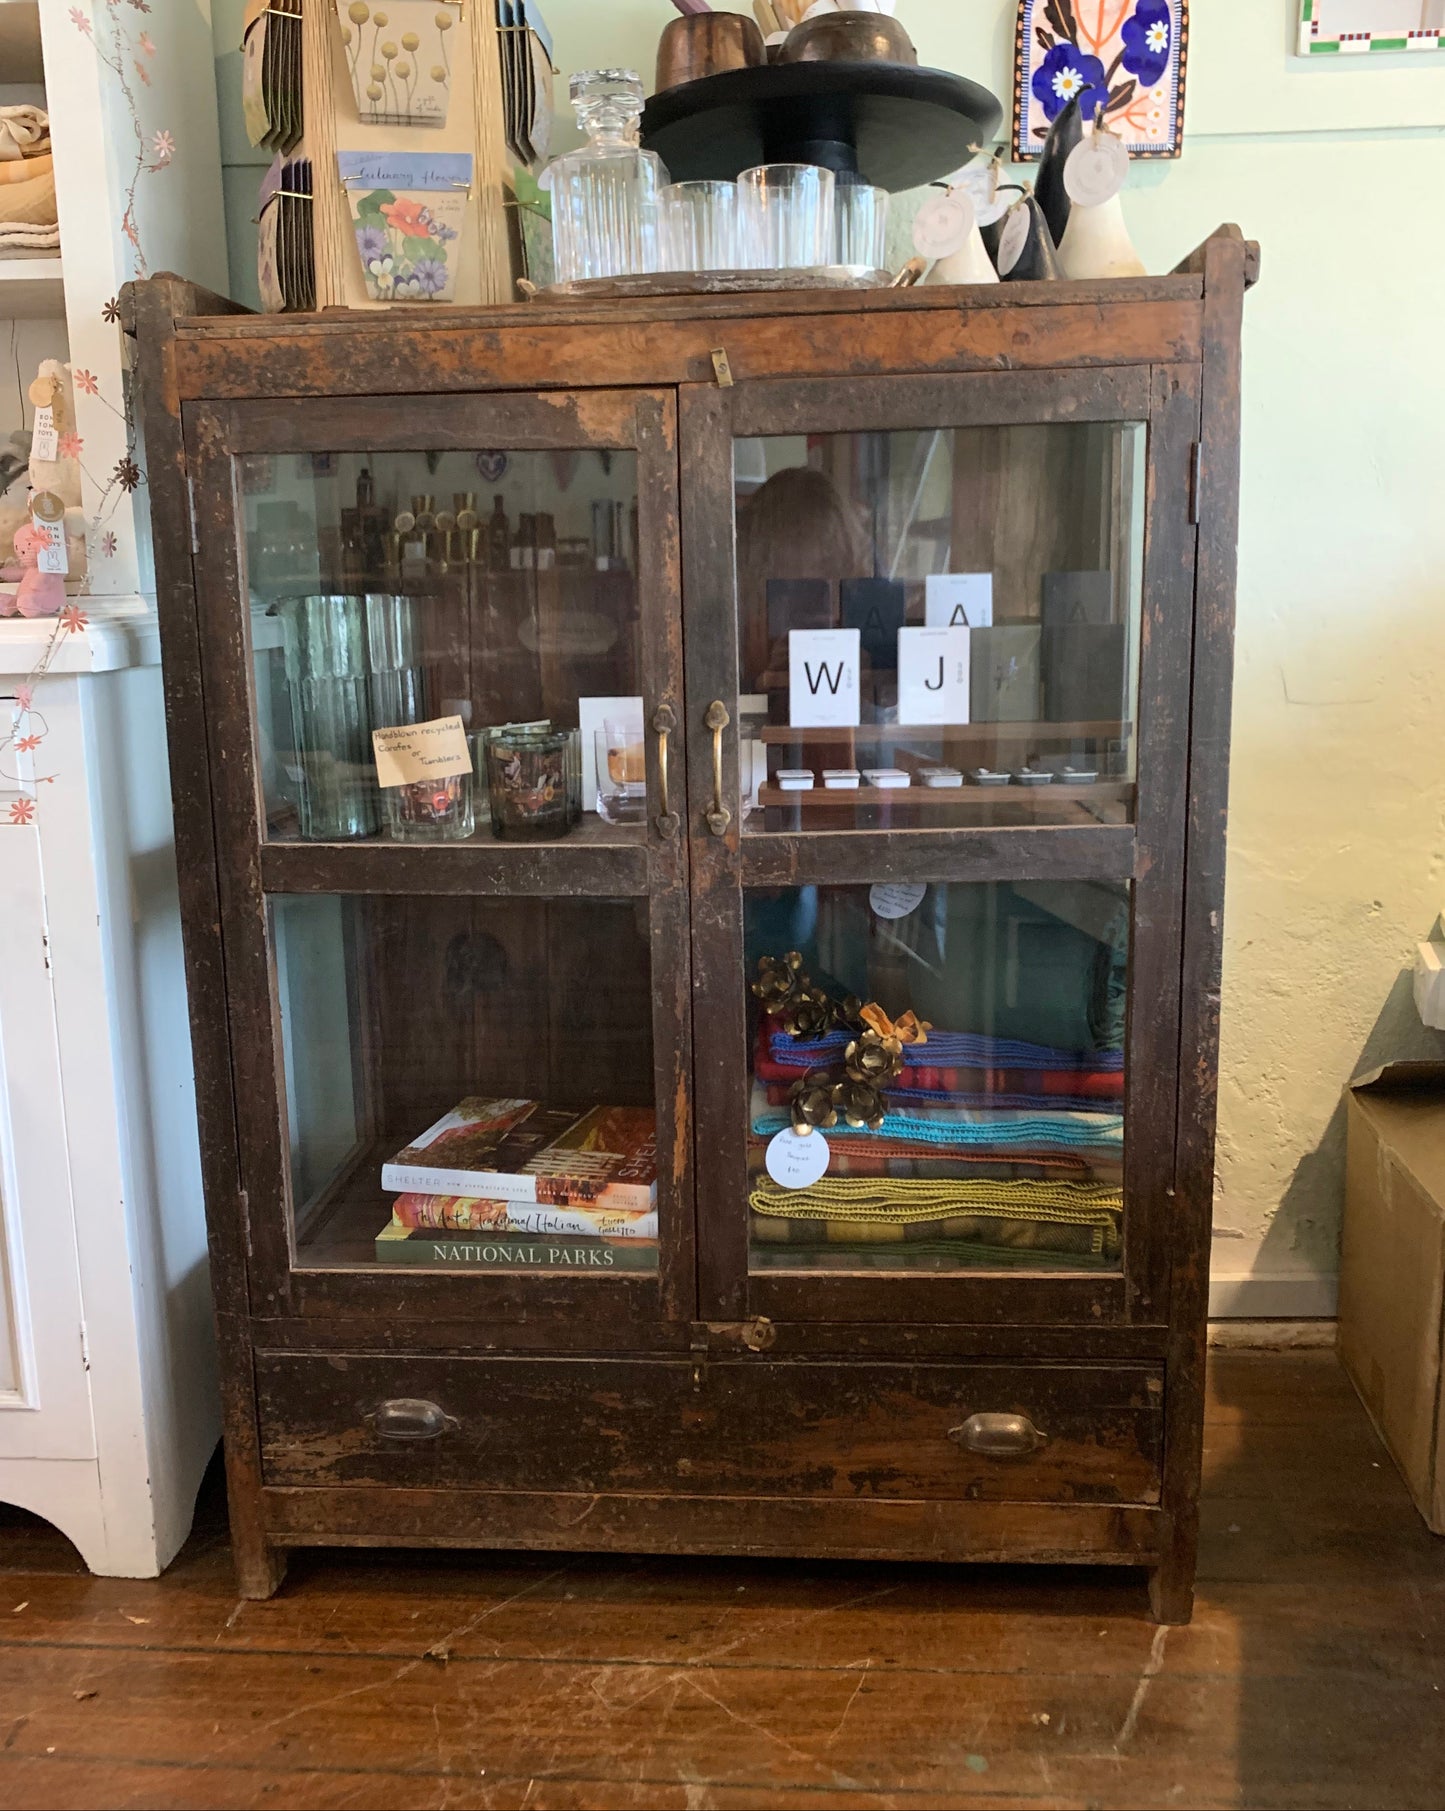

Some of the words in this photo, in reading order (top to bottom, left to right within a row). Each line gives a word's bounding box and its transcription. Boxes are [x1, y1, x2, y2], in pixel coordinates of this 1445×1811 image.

[804, 661, 845, 695] W
[924, 655, 944, 691] J
[420, 721, 461, 736] recycled
[411, 750, 422, 758] or
[387, 1174, 440, 1187] SHELTER
[535, 1212, 586, 1233] Italian
[433, 1245, 541, 1264] NATIONAL
[549, 1247, 614, 1266] PARKS
